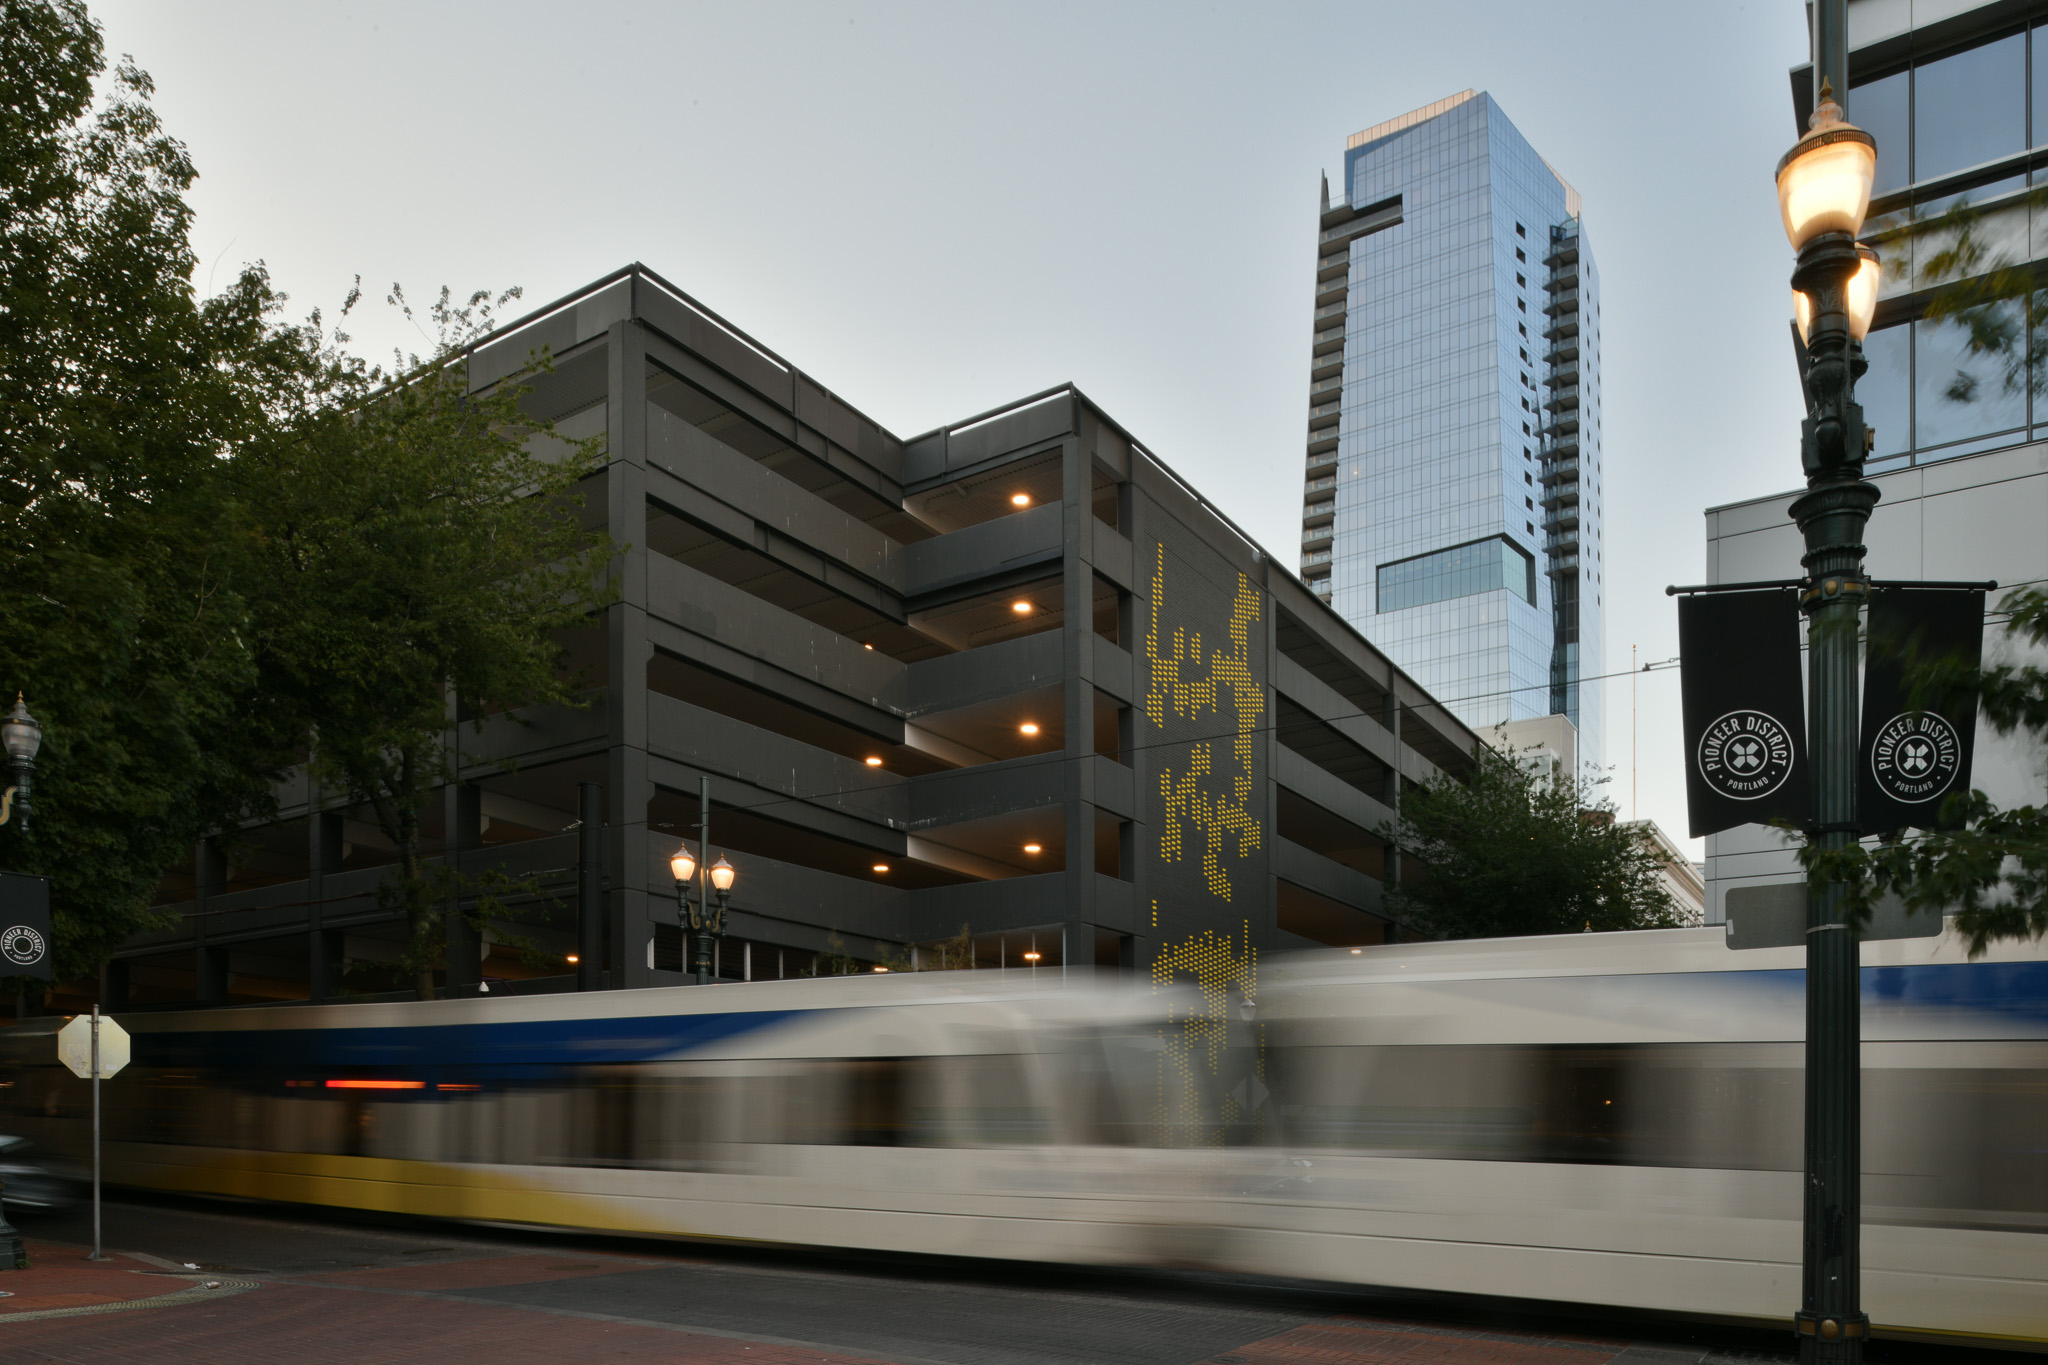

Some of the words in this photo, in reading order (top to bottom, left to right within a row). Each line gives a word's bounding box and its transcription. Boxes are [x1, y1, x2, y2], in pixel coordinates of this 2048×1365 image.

[1704, 718, 1741, 772] PIONEER
[1746, 716, 1787, 767] DISTRICT
[1877, 718, 1915, 771] PIONEER
[1919, 717, 1955, 772] DISTRICT
[1726, 776, 1770, 791] PORTLAND
[1894, 780, 1934, 794] PORTLAND
[4, 928, 21, 950] PIONEER
[23, 928, 42, 953] DISTRICT
